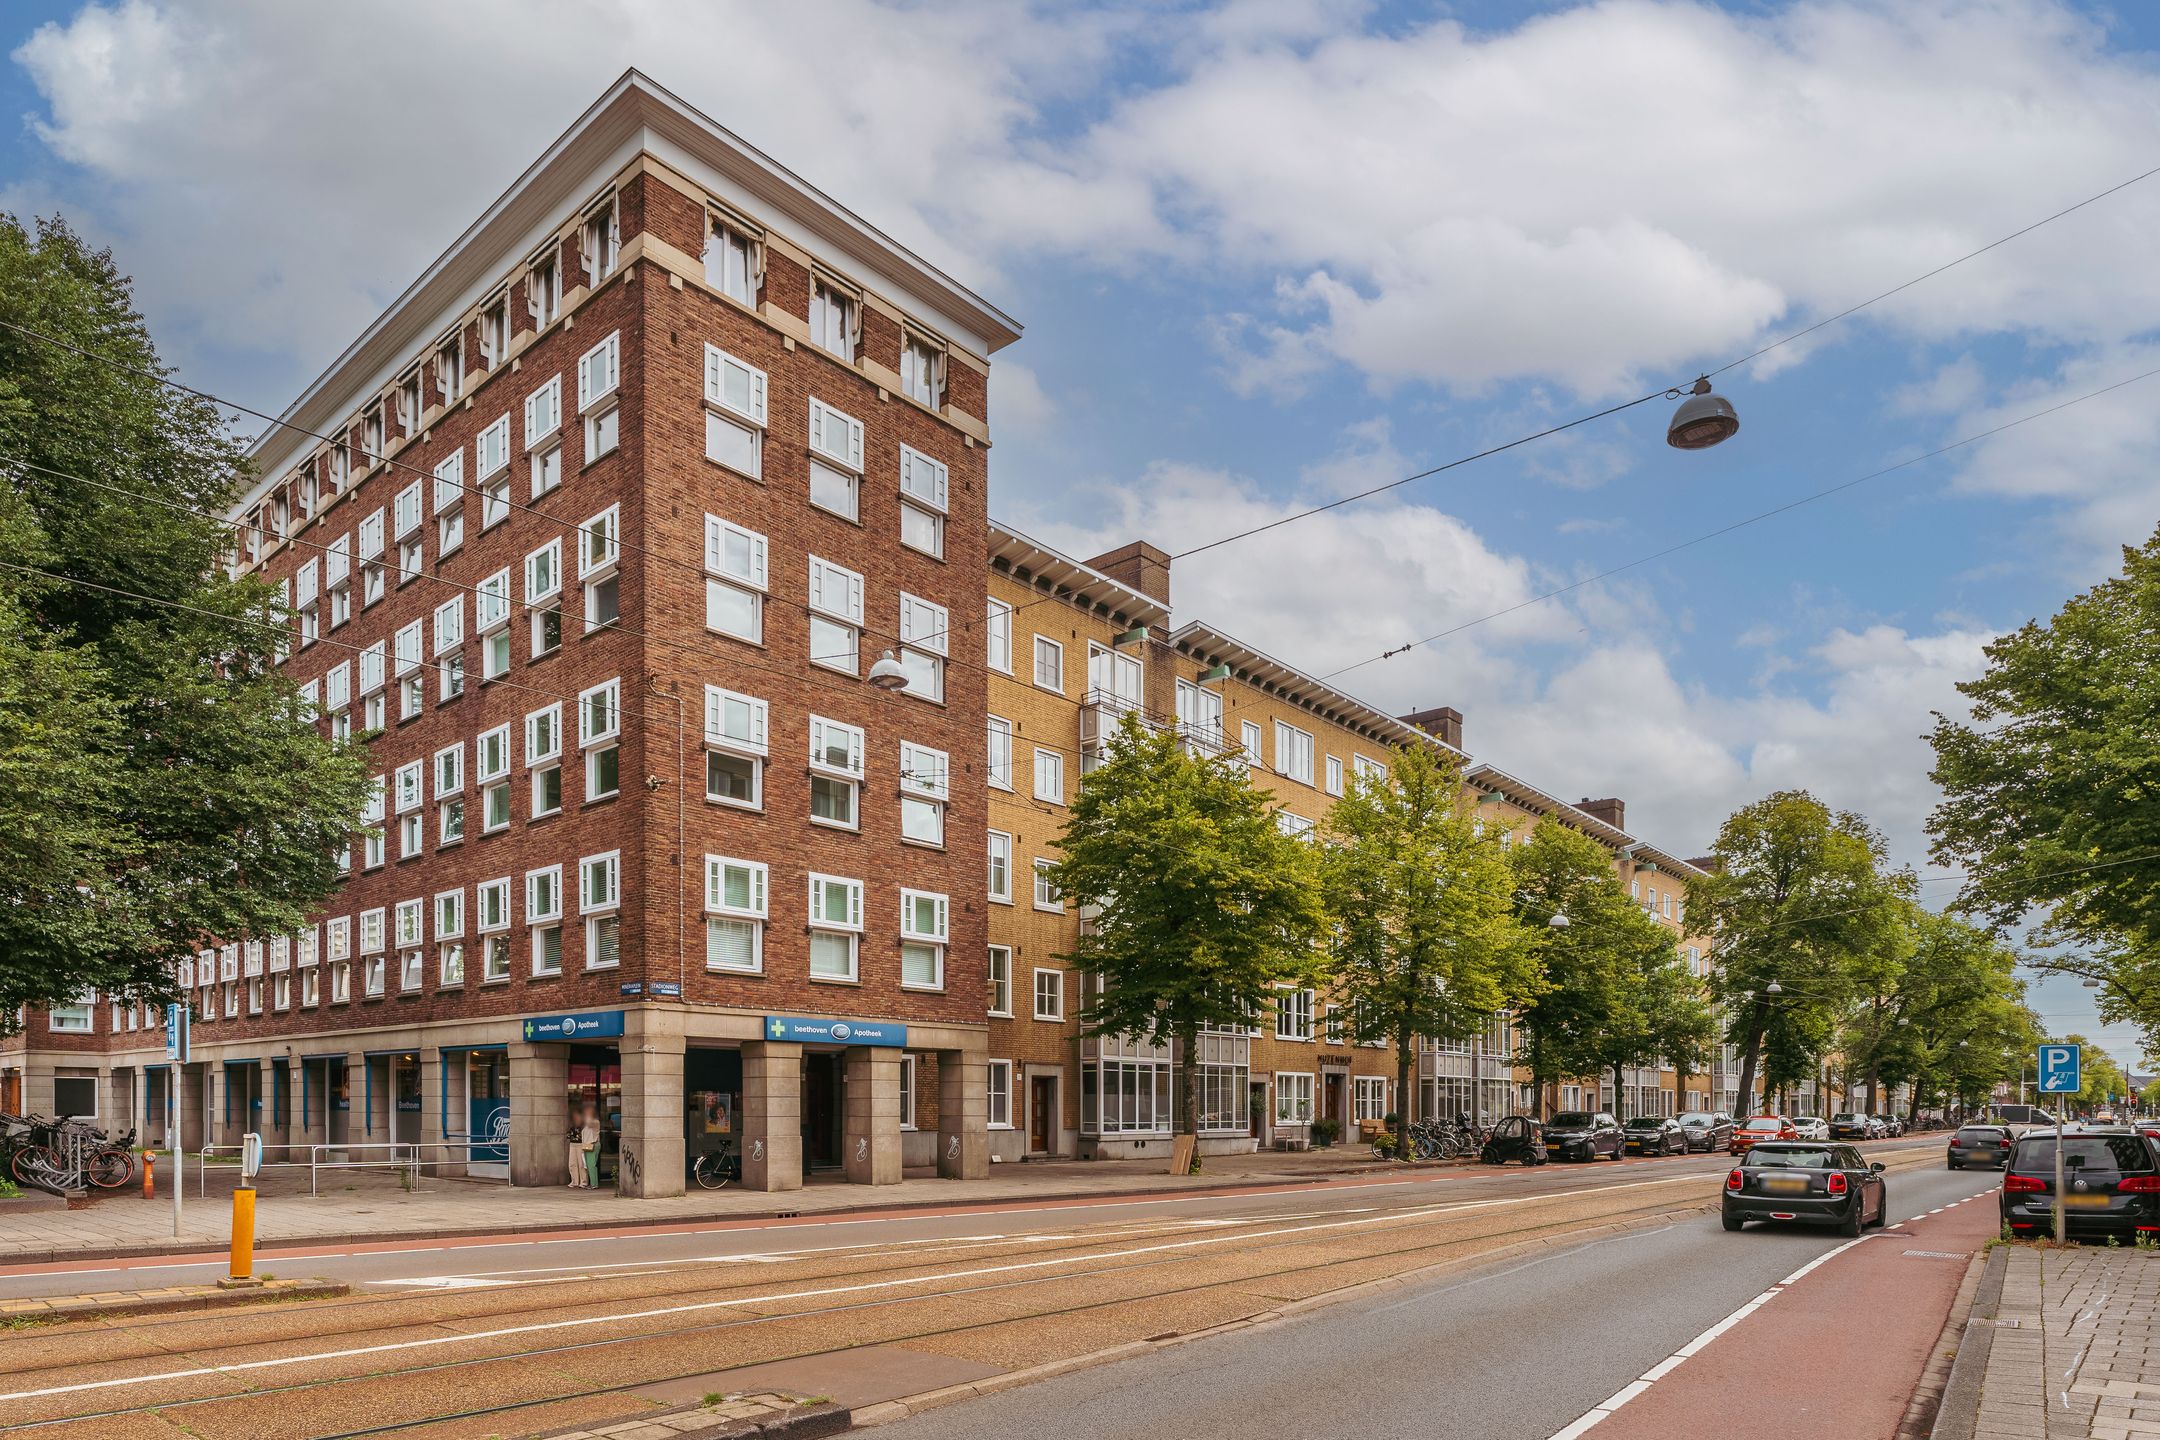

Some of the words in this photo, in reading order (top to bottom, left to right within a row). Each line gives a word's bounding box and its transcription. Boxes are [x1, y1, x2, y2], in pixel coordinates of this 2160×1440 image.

[650, 983, 679, 991] STADIONWEG
[538, 1024, 560, 1032] beethoven
[577, 1020, 599, 1030] Apotheek
[794, 1025, 827, 1034] beethoven
[854, 1029, 882, 1038] Apotheek
[2048, 1049, 2070, 1072] P
